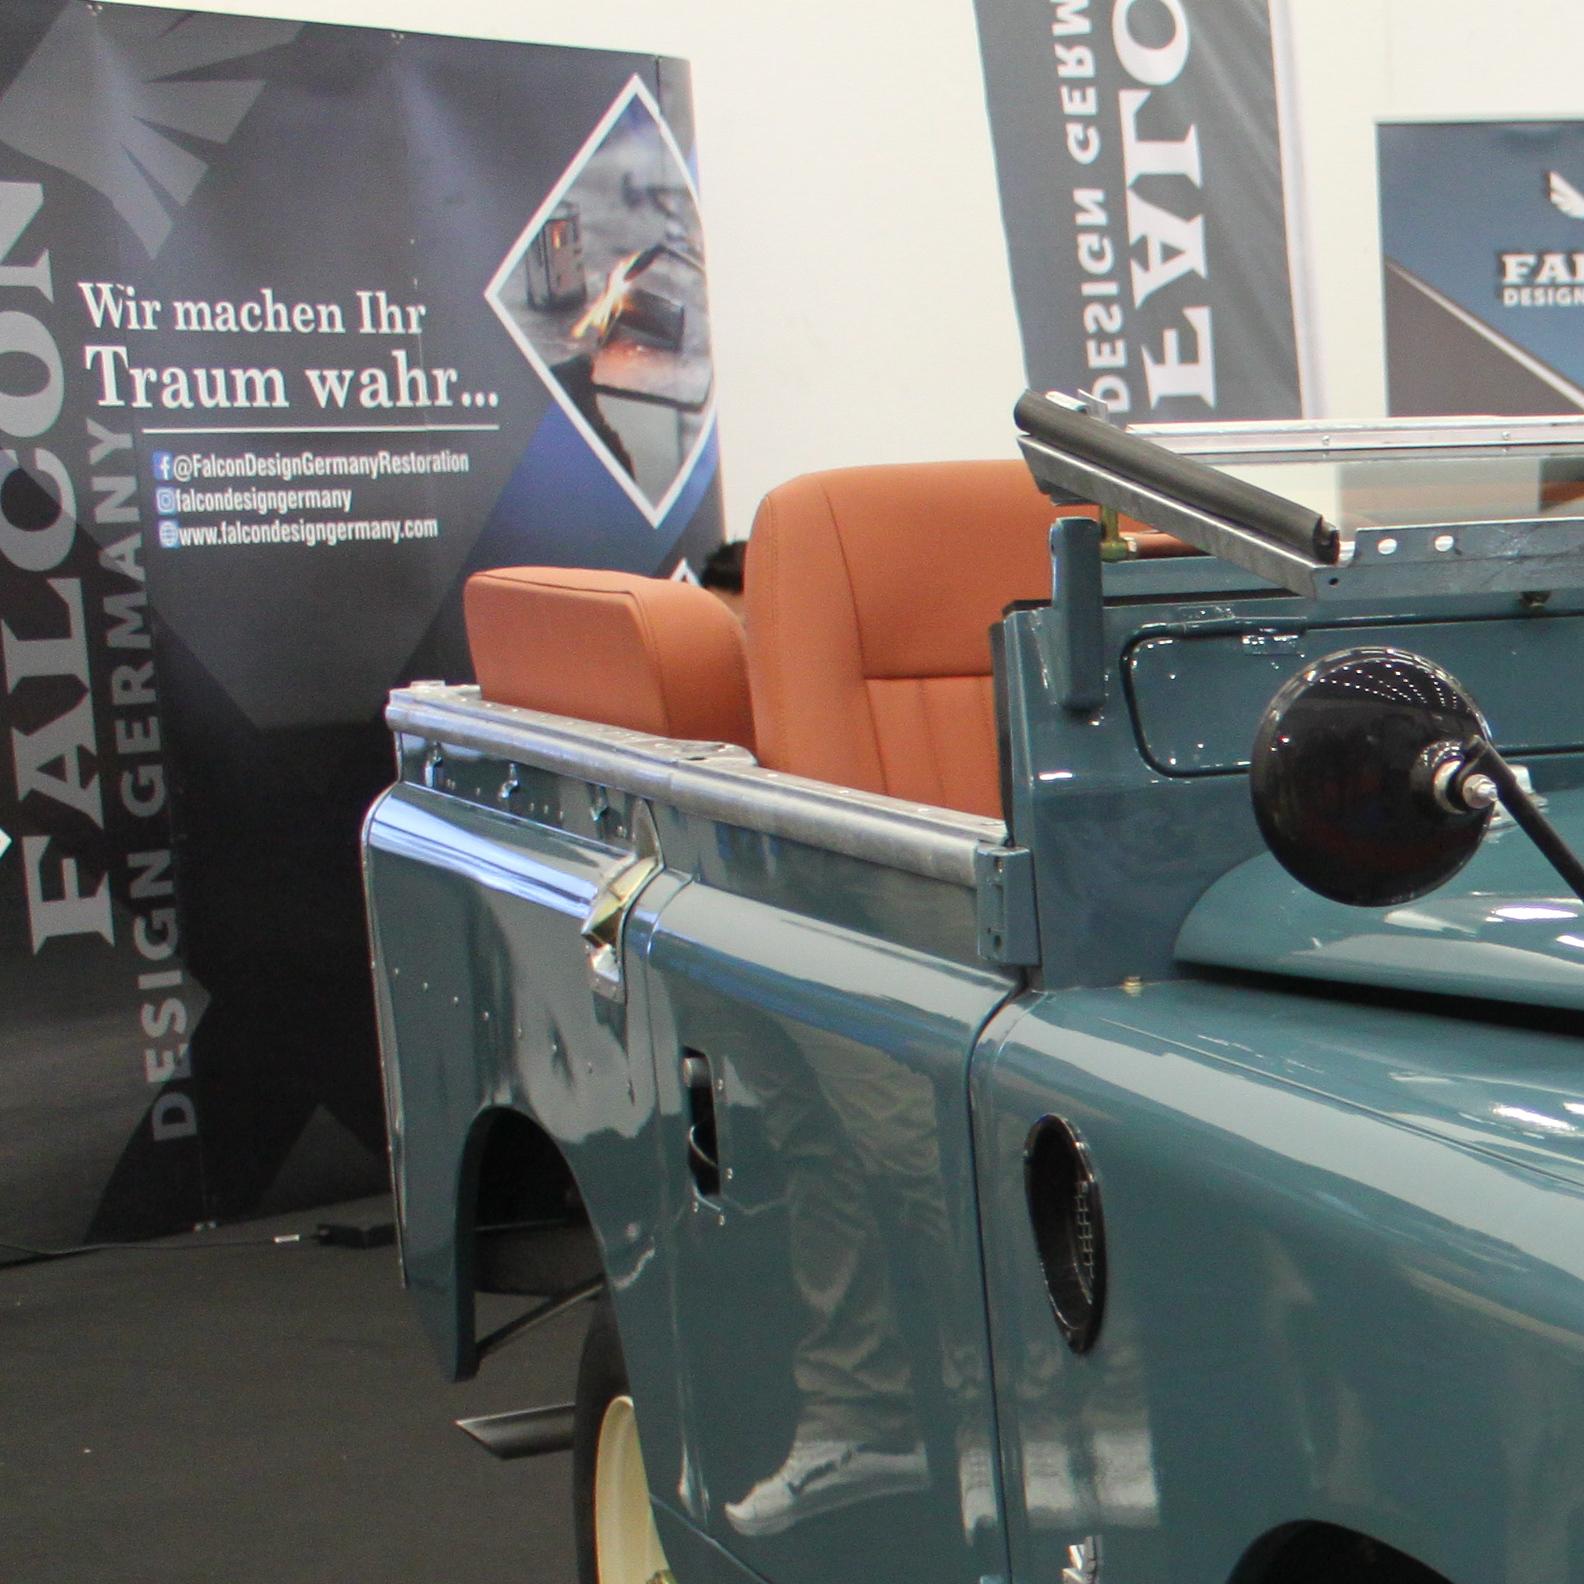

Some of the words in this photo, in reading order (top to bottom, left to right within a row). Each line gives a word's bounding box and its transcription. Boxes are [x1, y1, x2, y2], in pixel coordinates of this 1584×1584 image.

[78, 282, 162, 331] Wir
[174, 288, 346, 334] machen
[356, 290, 426, 334] Ihr
[84, 345, 290, 409] Traum
[305, 349, 499, 409] wahr...
[173, 450, 469, 481] @FalconDesignGermanyRestoration
[176, 488, 352, 513] falcondesigngermany
[178, 519, 438, 547] www.falcondesigngermany.com
[86, 417, 167, 818] GERMANY
[128, 848, 199, 1142] DESIGN
